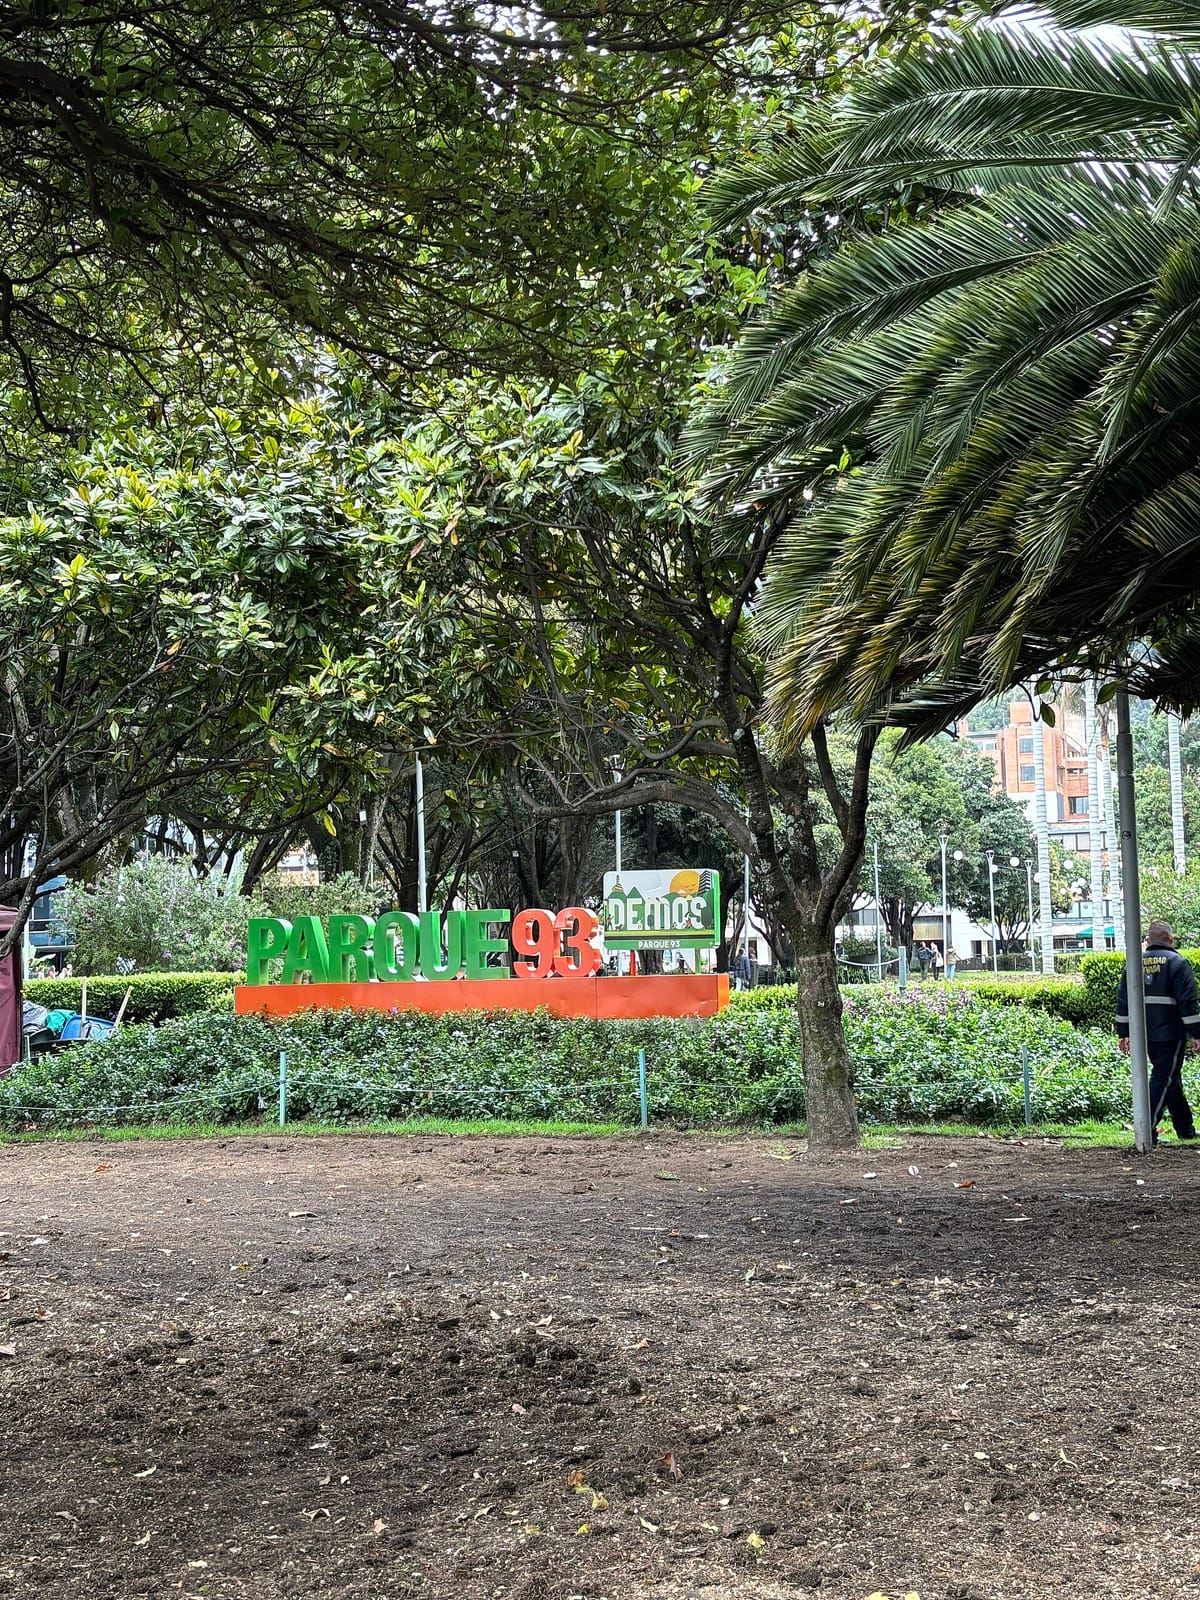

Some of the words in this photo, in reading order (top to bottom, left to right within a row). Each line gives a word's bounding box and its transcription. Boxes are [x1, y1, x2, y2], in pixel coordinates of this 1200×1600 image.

[608, 896, 707, 931] DEMOS
[249, 908, 511, 986] PARQUE
[511, 906, 601, 979] 93
[638, 941, 671, 949] PARQUE
